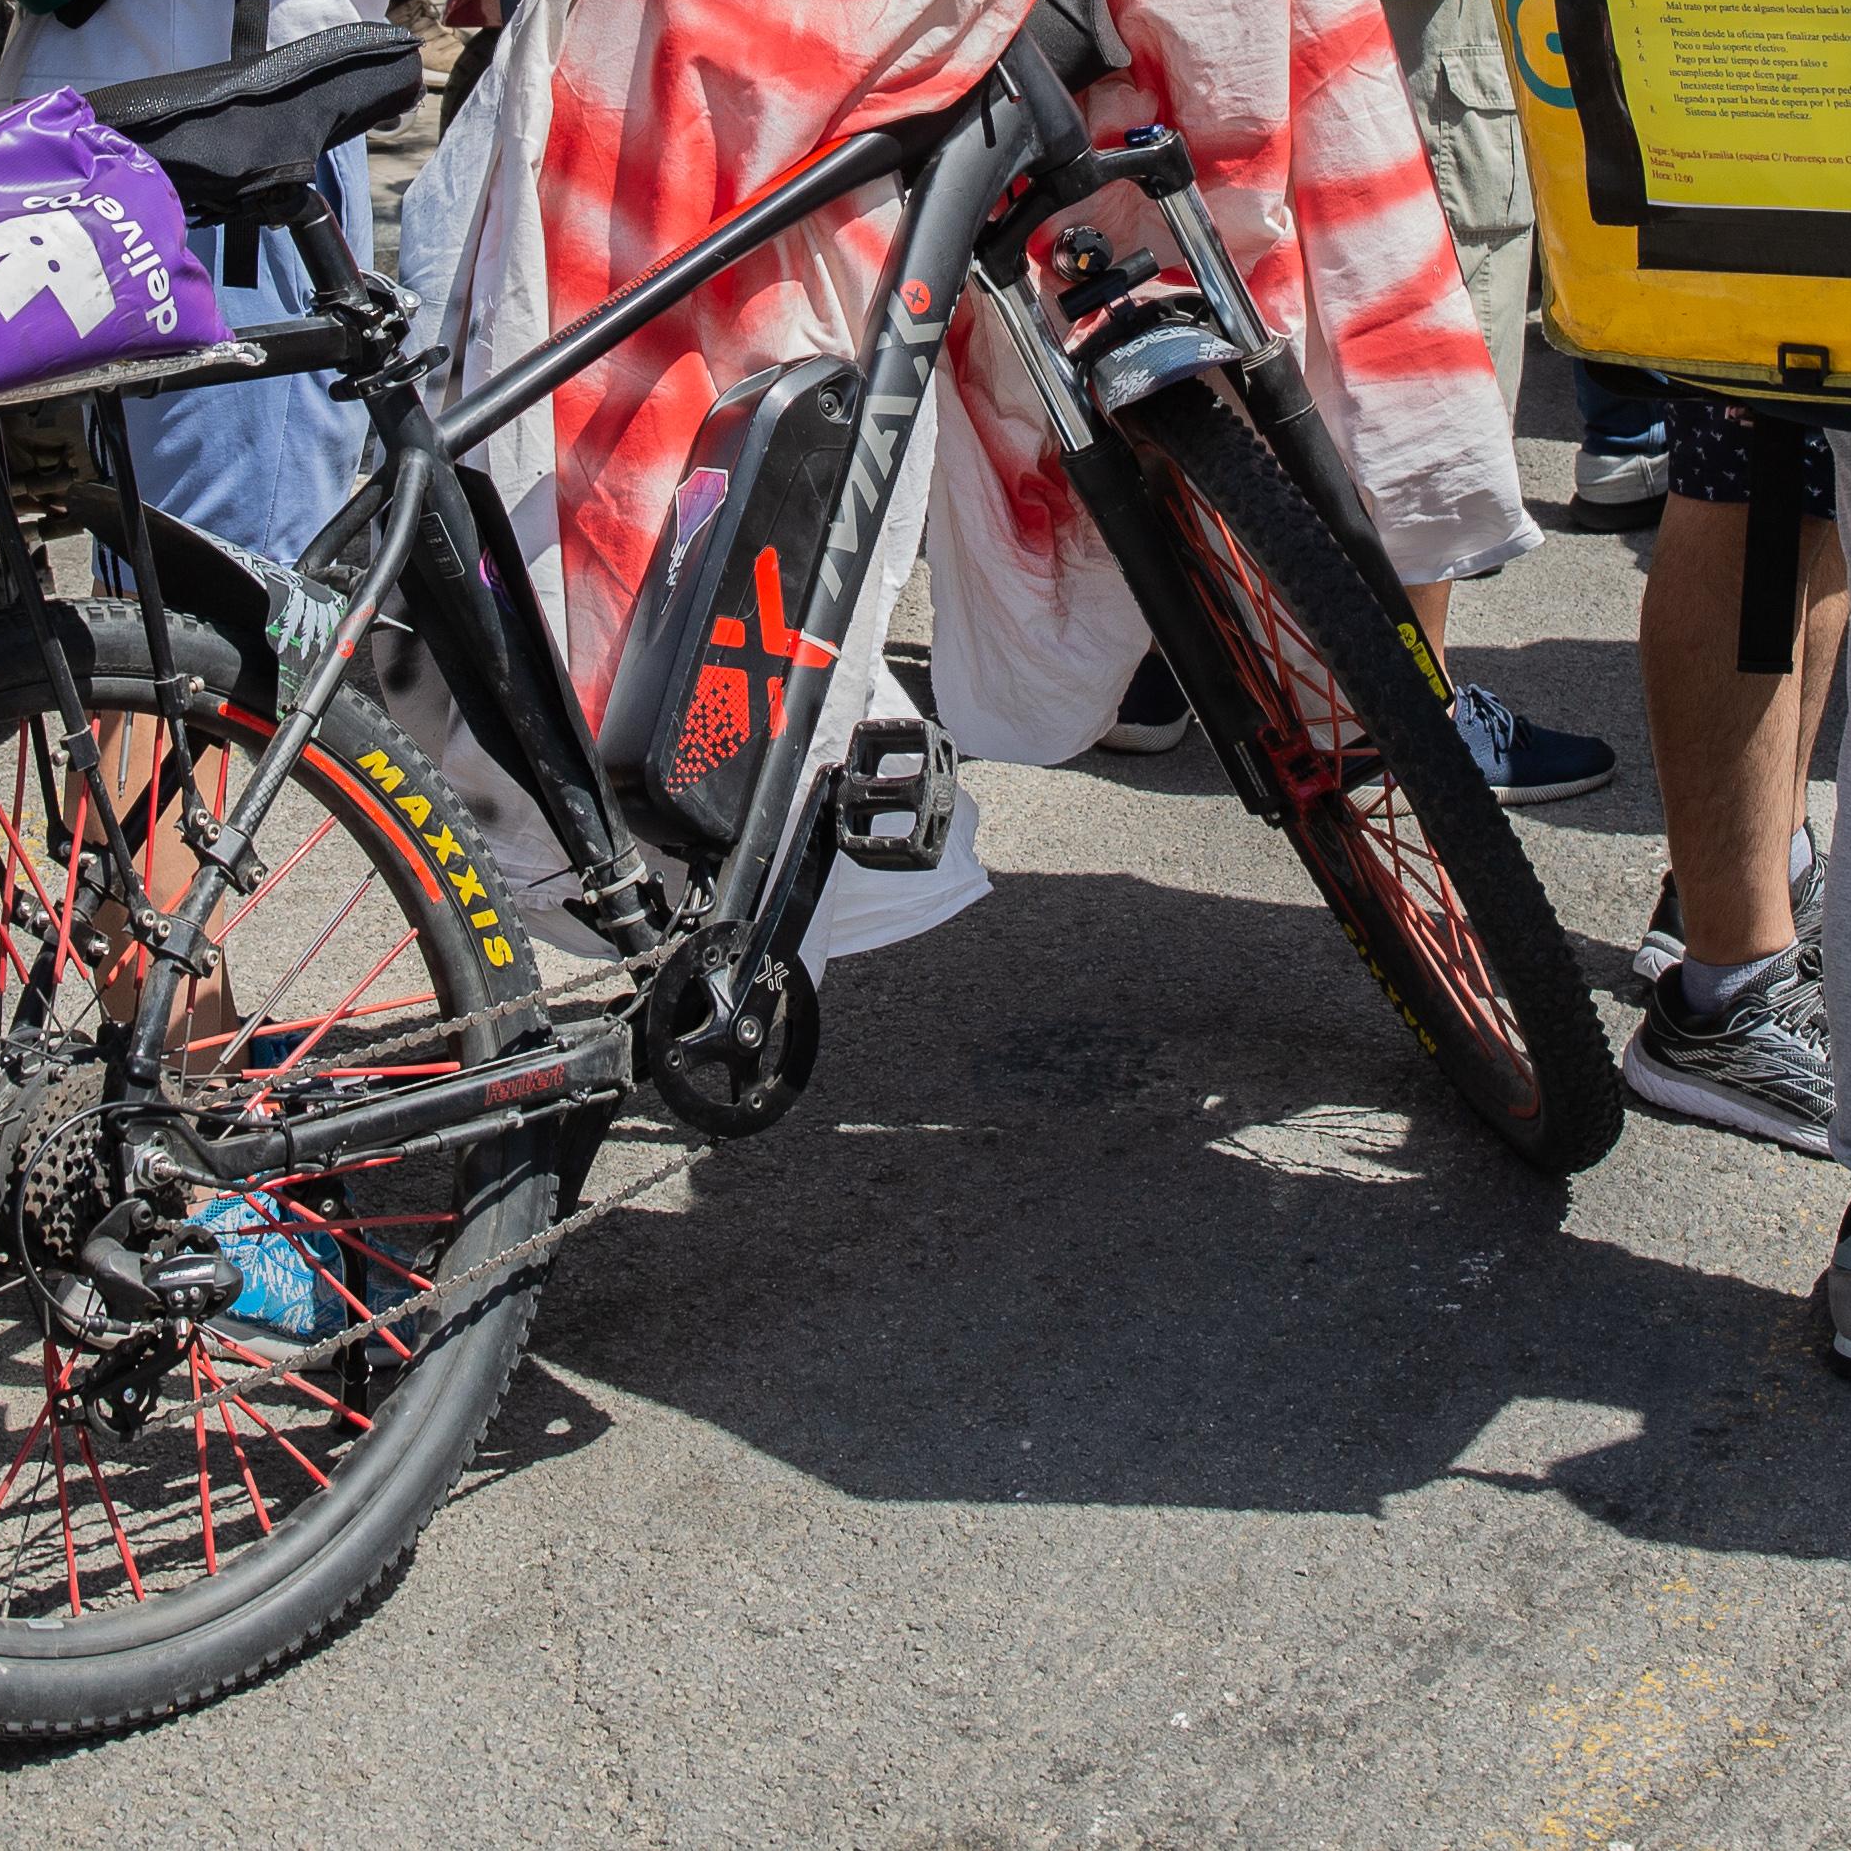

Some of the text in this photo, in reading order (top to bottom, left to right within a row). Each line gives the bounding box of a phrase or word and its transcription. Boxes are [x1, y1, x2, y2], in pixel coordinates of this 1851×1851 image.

[1666, 1, 1682, 11] Mal
[1684, 2, 1702, 11] trato
[1704, 3, 1717, 14] por
[1719, 3, 1740, 14] parte
[1742, 3, 1752, 12] de
[1787, 4, 1814, 14] locales
[1816, 4, 1839, 14] hacia
[1660, 14, 1684, 24] riders.
[1671, 28, 1700, 38] Presión
[1702, 29, 1726, 38] desde
[1727, 30, 1735, 38] la
[1736, 30, 1765, 40] oficina
[1767, 32, 1785, 41] para
[1786, 31, 1820, 41] finalizar
[1673, 41, 1694, 50] Poco
[1722, 43, 1752, 53] soporte
[1754, 44, 1788, 53] efectivo.
[1676, 54, 1697, 65] Pago
[1698, 57, 1711, 66] por
[1731, 56, 1759, 66] tiempo
[1761, 57, 1771, 66] de
[1773, 59, 1798, 68] espera
[1801, 58, 1821, 67] falso
[1669, 68, 1723, 79] incumpliendo
[1725, 69, 1734, 78] lo
[1736, 72, 1751, 80] que
[1753, 70, 1774, 79] dicen
[1680, 80, 1724, 90] Inexistente
[1726, 81, 1754, 92] tiempo
[1781, 84, 1792, 93] de
[1793, 86, 1819, 95] espera
[1821, 87, 1836, 96] por
[1674, 94, 1708, 104] llegando
[1717, 97, 1739, 105] pasar
[1741, 96, 1748, 104] la
[1750, 97, 1769, 105] hora
[1770, 97, 1780, 105] de
[1782, 98, 1808, 108] espera
[1810, 100, 1824, 108] por
[1685, 107, 1717, 117] Sistema
[1719, 109, 1729, 117] de
[1671, 149, 1701, 160] Sagrada
[1736, 152, 1770, 162] (esquina
[1771, 153, 1782, 161] C/
[22, 192, 178, 335] deliveroo
[358, 748, 514, 969] MAXXIS
